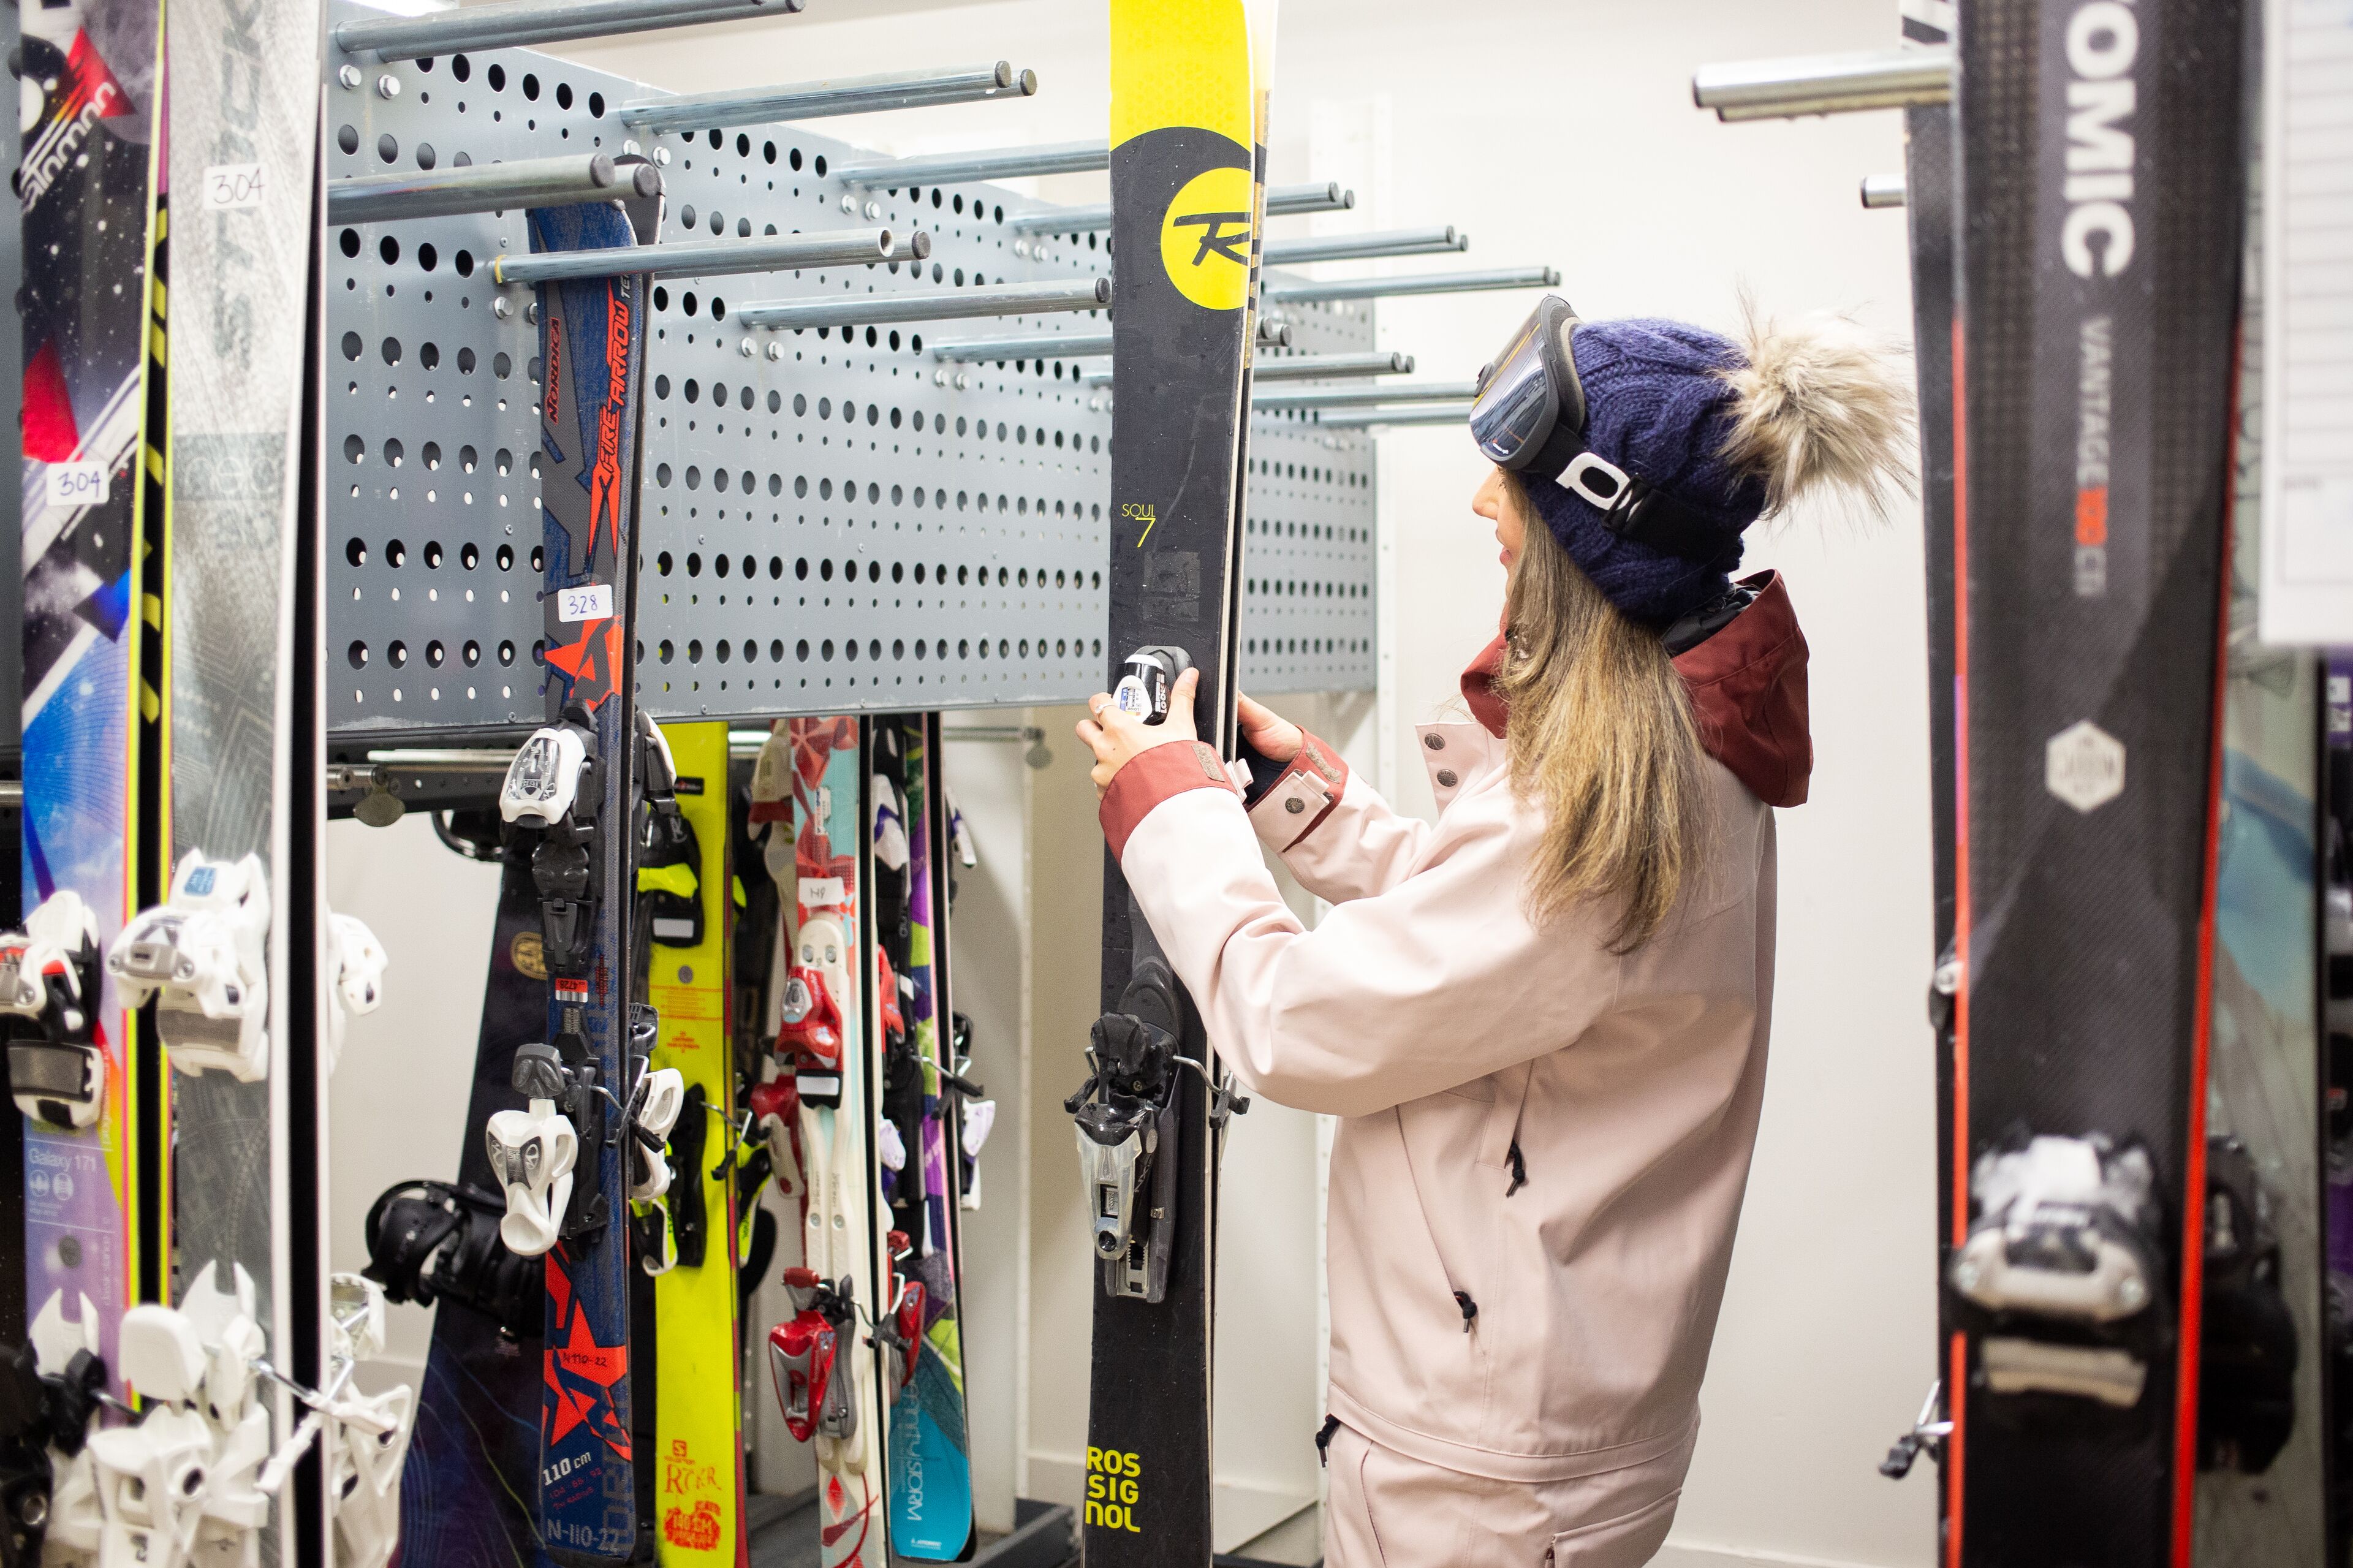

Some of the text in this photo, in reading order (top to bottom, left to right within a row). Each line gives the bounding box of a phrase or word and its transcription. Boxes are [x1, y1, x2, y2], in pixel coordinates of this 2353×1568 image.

[2061, 0, 2140, 277] OMIC
[211, 168, 264, 203] 304
[545, 317, 561, 425] NORDICA
[599, 273, 631, 474] FIRE ARROW TE
[58, 471, 101, 498] 304
[1121, 504, 1156, 518] SOUL
[1135, 517, 1157, 548] 7
[568, 594, 598, 615] 328
[29, 1147, 97, 1173] Galaxy 171
[543, 1452, 592, 1486] 110 cm
[1087, 1446, 1140, 1477] ROS
[906, 1461, 923, 1520] STORM
[1088, 1474, 1139, 1502] SIG
